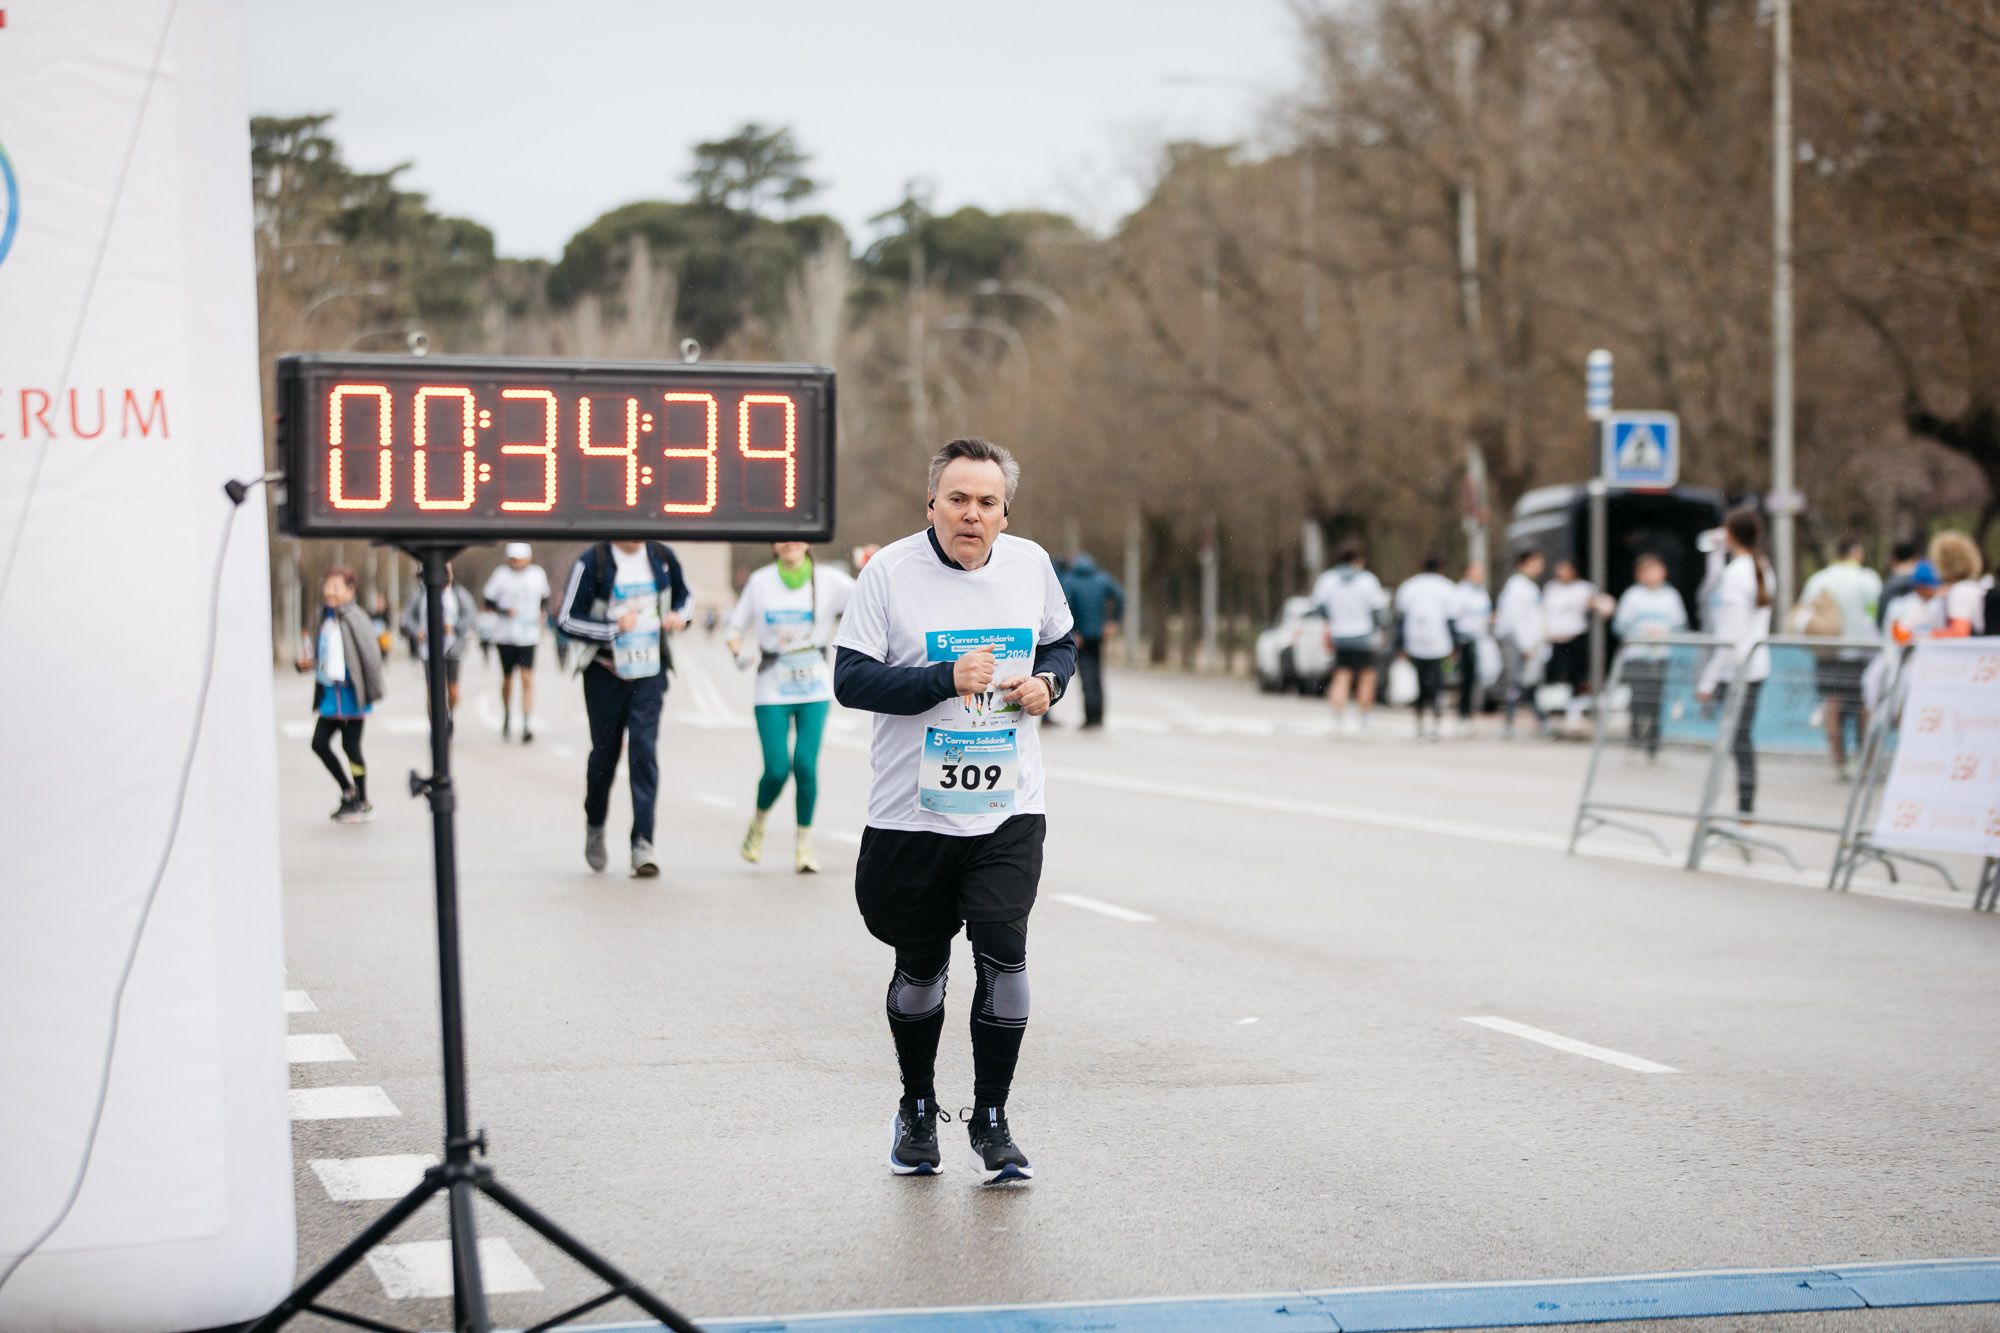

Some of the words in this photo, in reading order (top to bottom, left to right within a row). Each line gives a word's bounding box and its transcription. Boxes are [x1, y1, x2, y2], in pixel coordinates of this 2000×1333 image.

[0, 387, 170, 439] RUM
[329, 384, 797, 513] 00:34:39
[949, 636, 979, 645] Carrera
[980, 635, 1015, 644] Solidaria
[945, 736, 975, 745] Carrera
[976, 736, 1006, 745] Solidaria
[940, 764, 1002, 790] 309
